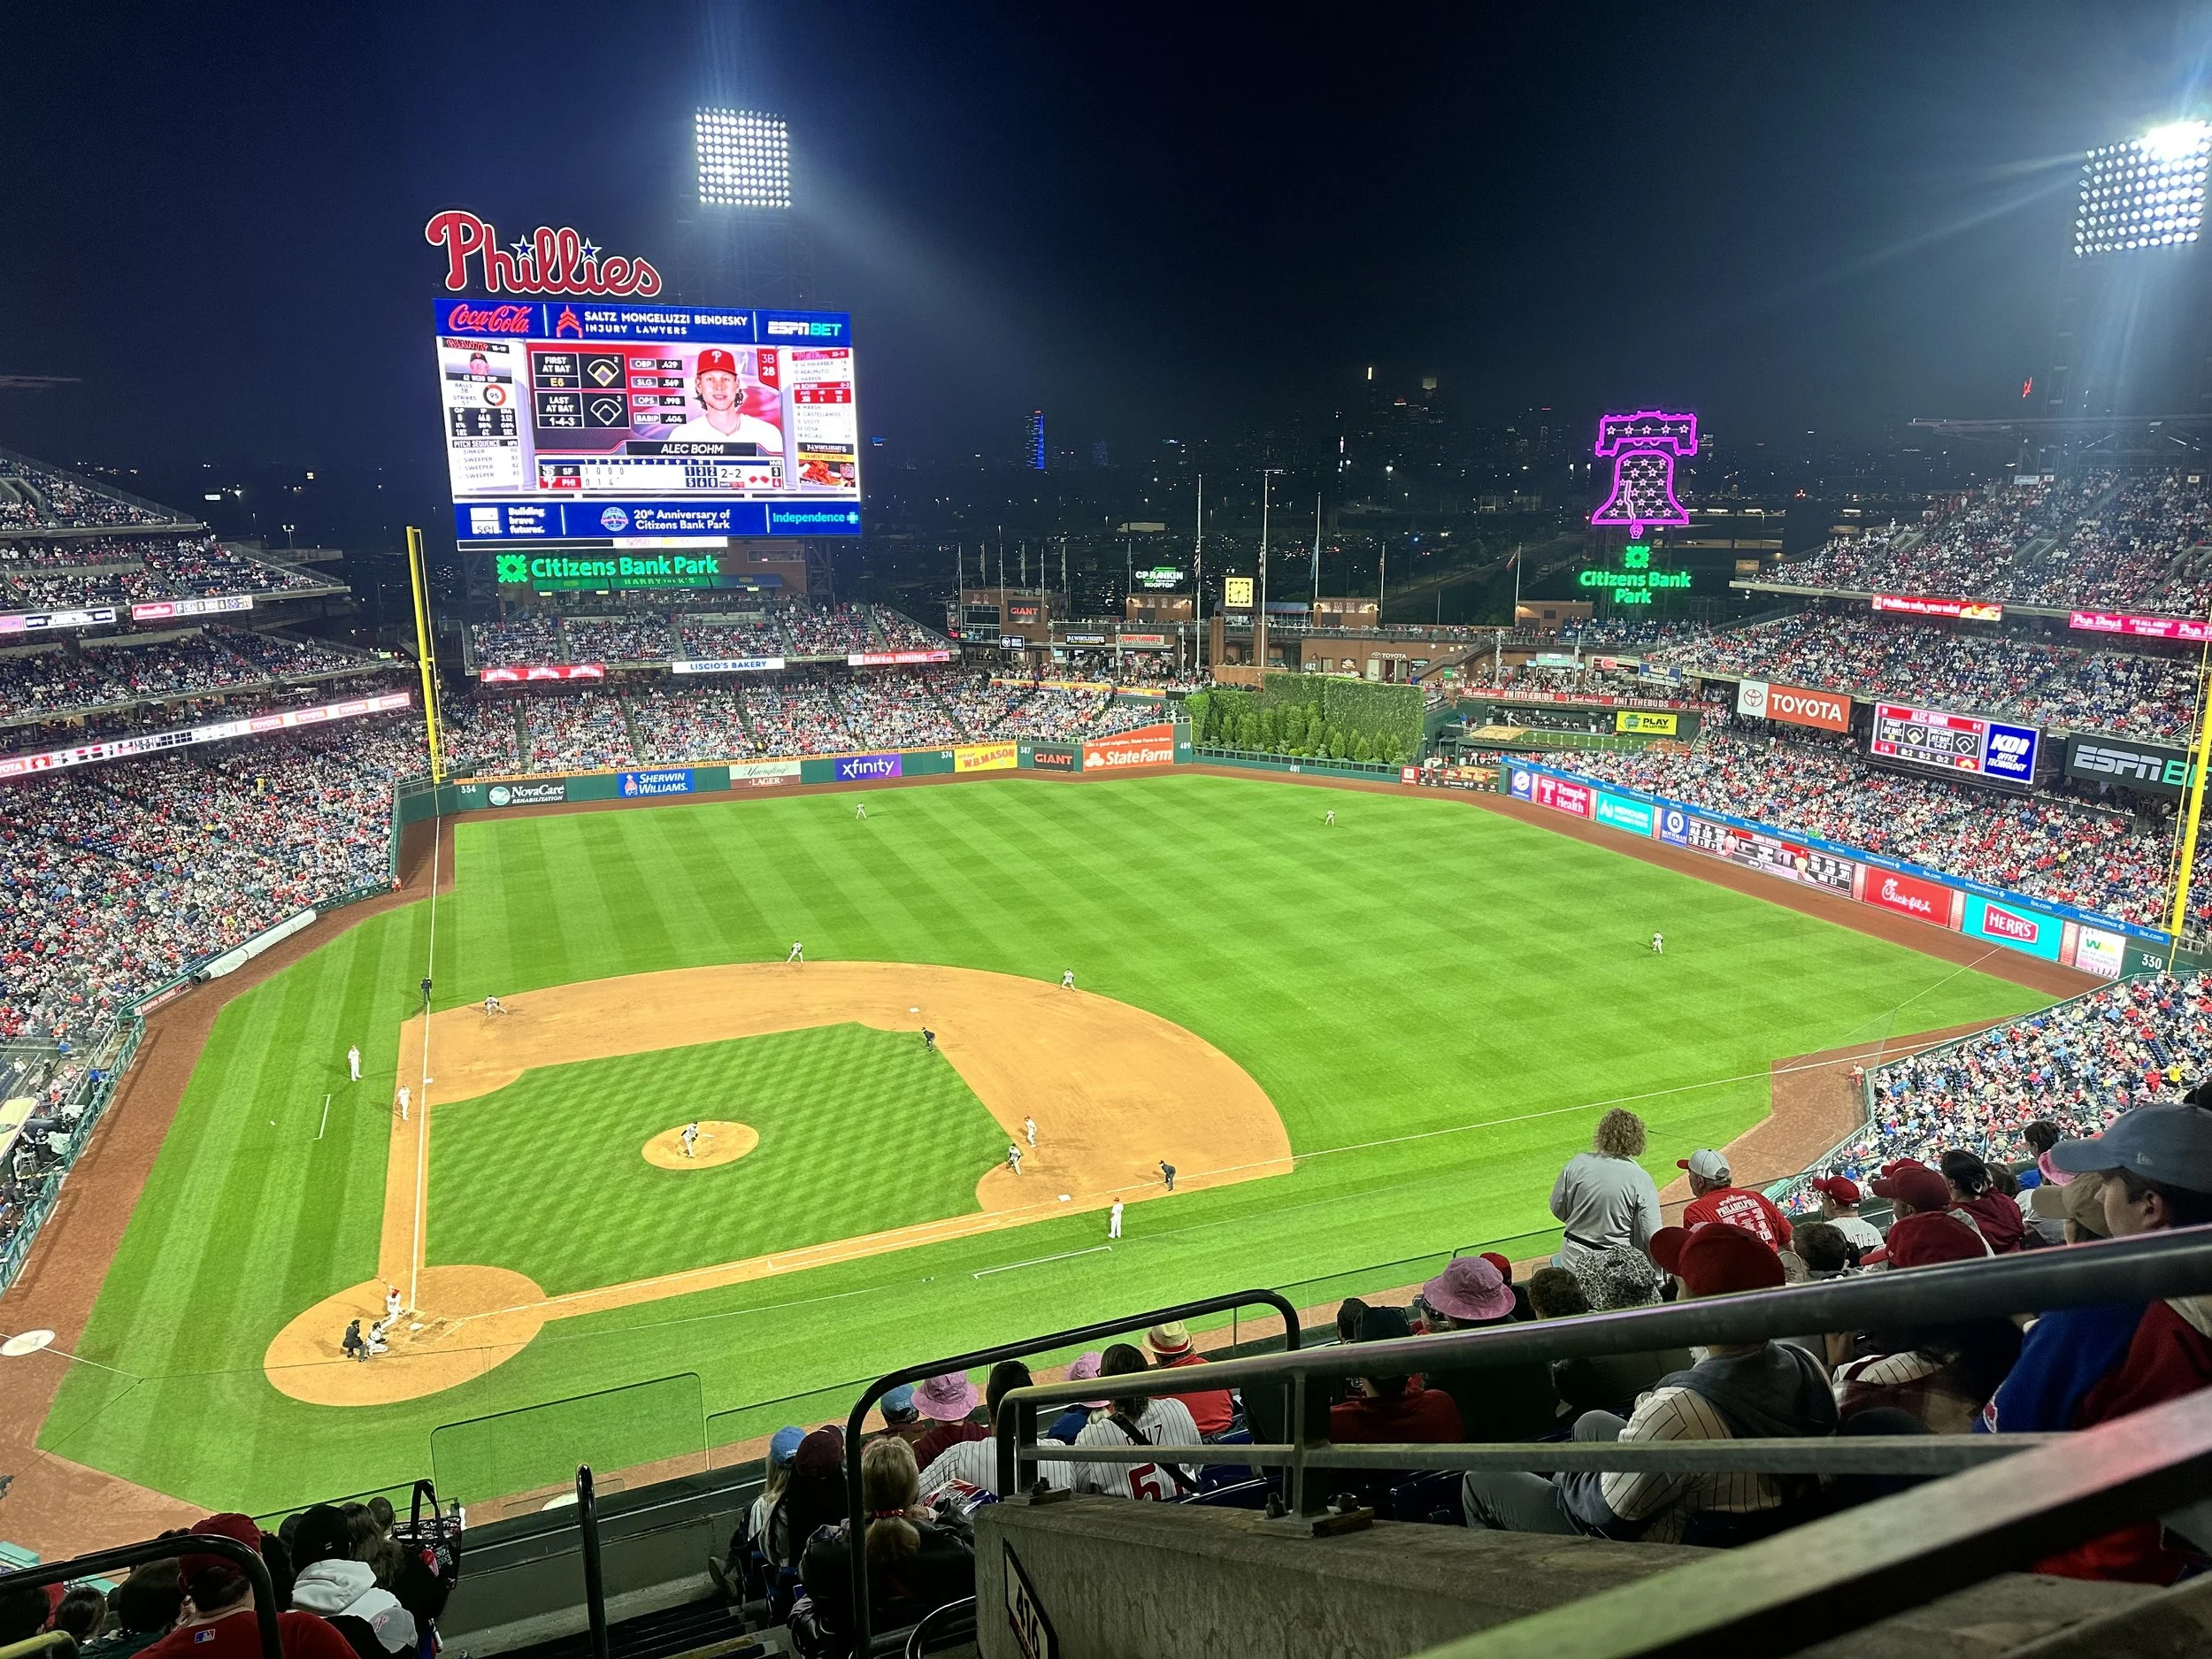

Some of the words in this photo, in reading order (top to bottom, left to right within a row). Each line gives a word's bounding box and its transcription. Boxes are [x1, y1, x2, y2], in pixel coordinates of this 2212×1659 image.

[426, 210, 662, 297] Phillies
[449, 303, 533, 334] Coca-Cola
[584, 311, 617, 322] SALTZ
[621, 312, 690, 324] MONGELUZZI
[695, 314, 748, 326] BENDESKY
[585, 324, 627, 334] INJURY
[636, 325, 687, 335] LAWYERS
[768, 321, 810, 334] ESPN
[810, 323, 841, 336] BET
[761, 354, 775, 364] 3B
[762, 366, 775, 377] 28
[549, 378, 565, 387] E6
[549, 396, 569, 405] LAST
[549, 418, 575, 426] 1-4-3
[661, 444, 689, 454] ALEC
[691, 444, 724, 455] BOHM
[721, 468, 741, 478] 2-2
[508, 507, 545, 517] Building
[634, 510, 655, 519] 20th
[657, 510, 717, 521] Anniversary
[718, 510, 731, 518] of
[773, 511, 845, 524] Independence
[635, 519, 679, 530] Citizens
[681, 519, 704, 529] Bank
[708, 519, 730, 529] Park
[531, 557, 616, 577] Citizens
[619, 556, 671, 575] Bank
[674, 556, 718, 574] Park
[1135, 571, 1148, 580] CP
[1150, 572, 1184, 580] RANKIN
[1580, 572, 1646, 586] Citizens
[1648, 572, 1692, 588] Bank
[1616, 588, 1653, 603] Park
[1883, 598, 1909, 609] Phillies
[1911, 601, 1926, 611] win,
[1926, 604, 1942, 614] you
[1943, 603, 1961, 614] win!
[2074, 614, 2093, 626] Pep
[2095, 616, 2122, 629] Boys
[864, 655, 894, 664] RAV4th
[895, 653, 926, 663] INNING
[690, 662, 728, 671] LISCIO'S
[731, 660, 767, 669] BAKERY
[1462, 688, 1498, 698] Budweiser
[381, 696, 407, 708] TOYOTA
[1612, 696, 1669, 708] #HITTHEBUDS
[1771, 694, 1842, 722] TOYOTA
[341, 703, 367, 714] TOYOTA
[297, 710, 326, 720] TOYOTA
[1910, 710, 1927, 722] ALEC
[1928, 713, 1948, 726] BOHM
[253, 717, 281, 728] TOYOTA
[1990, 734, 2031, 756] KDI
[1035, 753, 1072, 765] GIANT
[1997, 752, 2019, 763] OFFICE
[2074, 745, 2162, 781] ESPN
[743, 764, 787, 777] Yuengling
[842, 759, 895, 779] xfinity
[1987, 757, 2027, 772] TECHNOLOGY
[639, 773, 685, 784] SHERWIN
[752, 777, 781, 786] LAGER
[511, 785, 565, 796] NovaCare
[1557, 783, 1586, 802] Temple
[1556, 798, 1584, 814] Health
[1777, 831, 1803, 841] Independence
[1865, 855, 1894, 867] Independence
[1923, 871, 1941, 879] ibx.com
[1965, 882, 1998, 895] Independence
[2031, 900, 2052, 910] ibx.com
[2079, 913, 2117, 928] Independence
[2139, 929, 2164, 941] ibx.com
[1882, 882, 1932, 913] Chick-fil-A
[1989, 913, 2032, 938] HERR'S
[2141, 954, 2162, 970] 330
[1716, 1199, 1759, 1217] PHILADELPHIA
[375, 1614, 389, 1633] P
